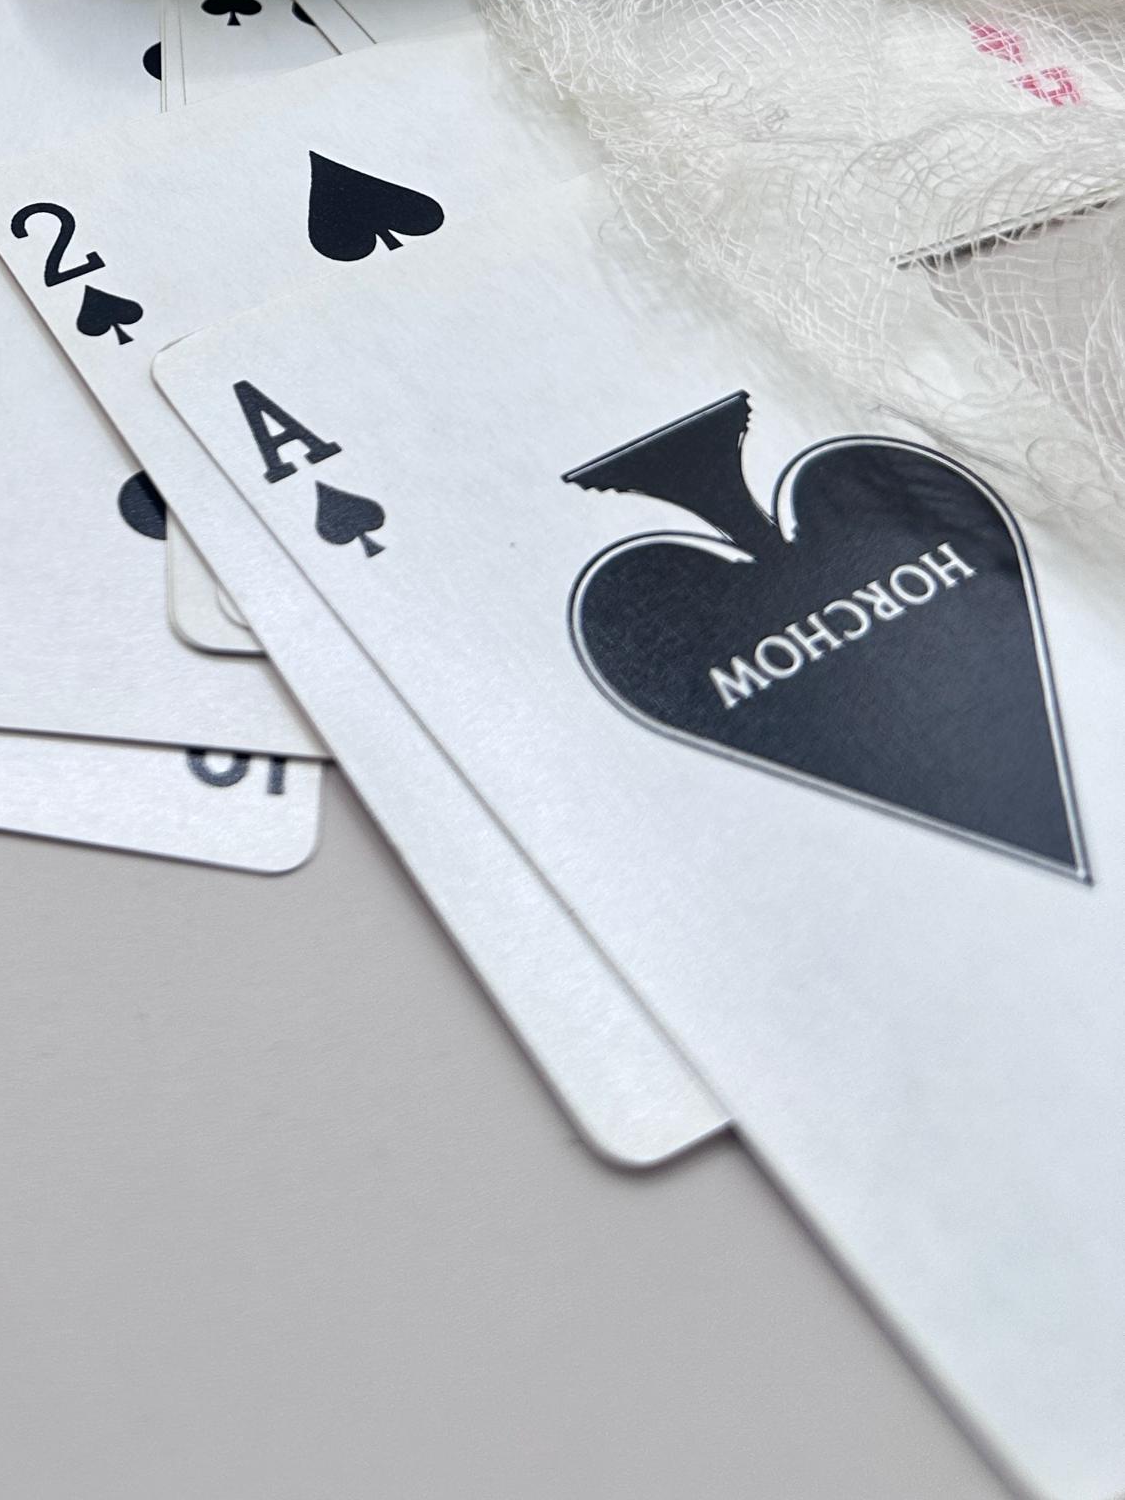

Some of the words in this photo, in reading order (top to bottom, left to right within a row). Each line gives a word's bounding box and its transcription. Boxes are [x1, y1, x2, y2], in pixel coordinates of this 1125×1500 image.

[10, 202, 106, 287] 2
[232, 379, 342, 485] A
[709, 541, 977, 710] HORCHOW
